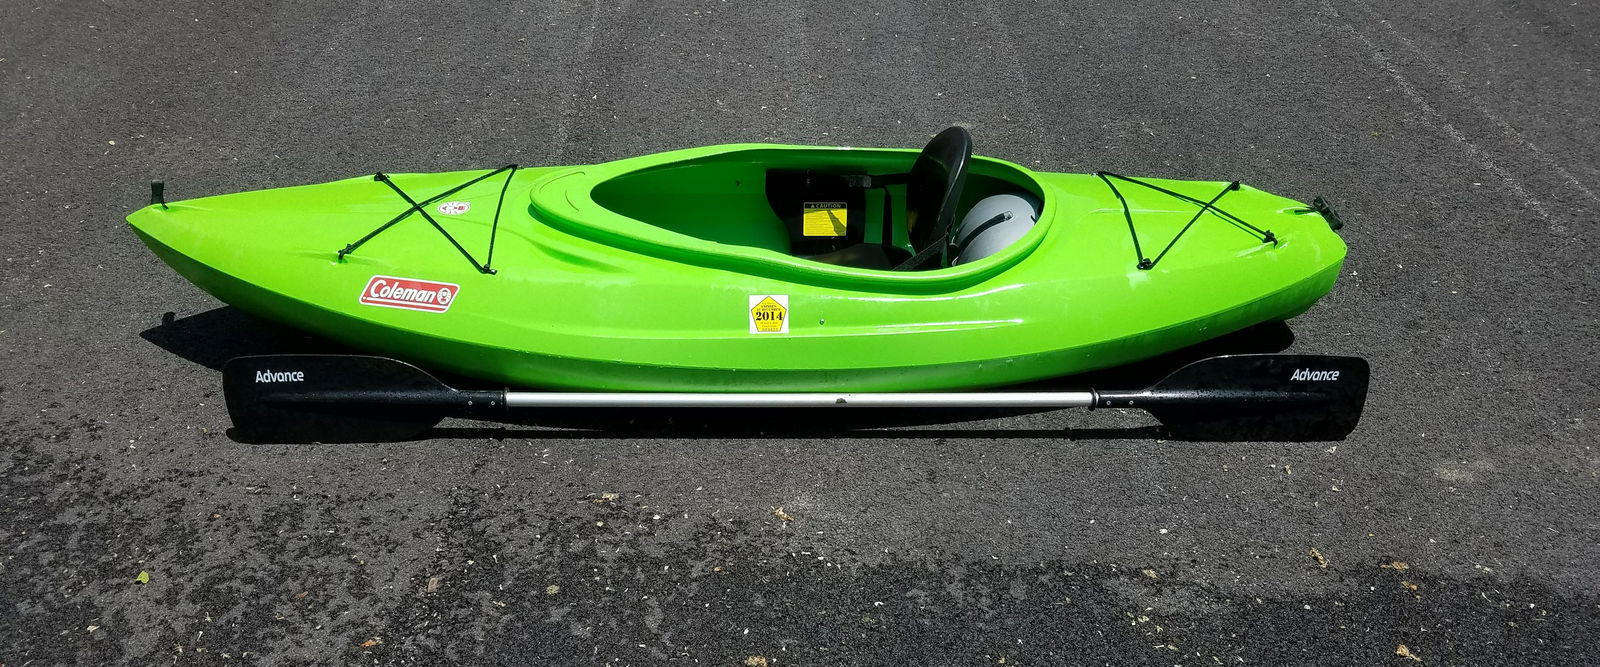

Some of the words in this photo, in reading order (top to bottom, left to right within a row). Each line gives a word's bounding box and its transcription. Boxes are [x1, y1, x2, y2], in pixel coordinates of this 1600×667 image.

[370, 279, 436, 303] Coleman
[756, 312, 783, 320] 2014
[256, 369, 304, 383] Advance
[1290, 368, 1340, 381] Advance
